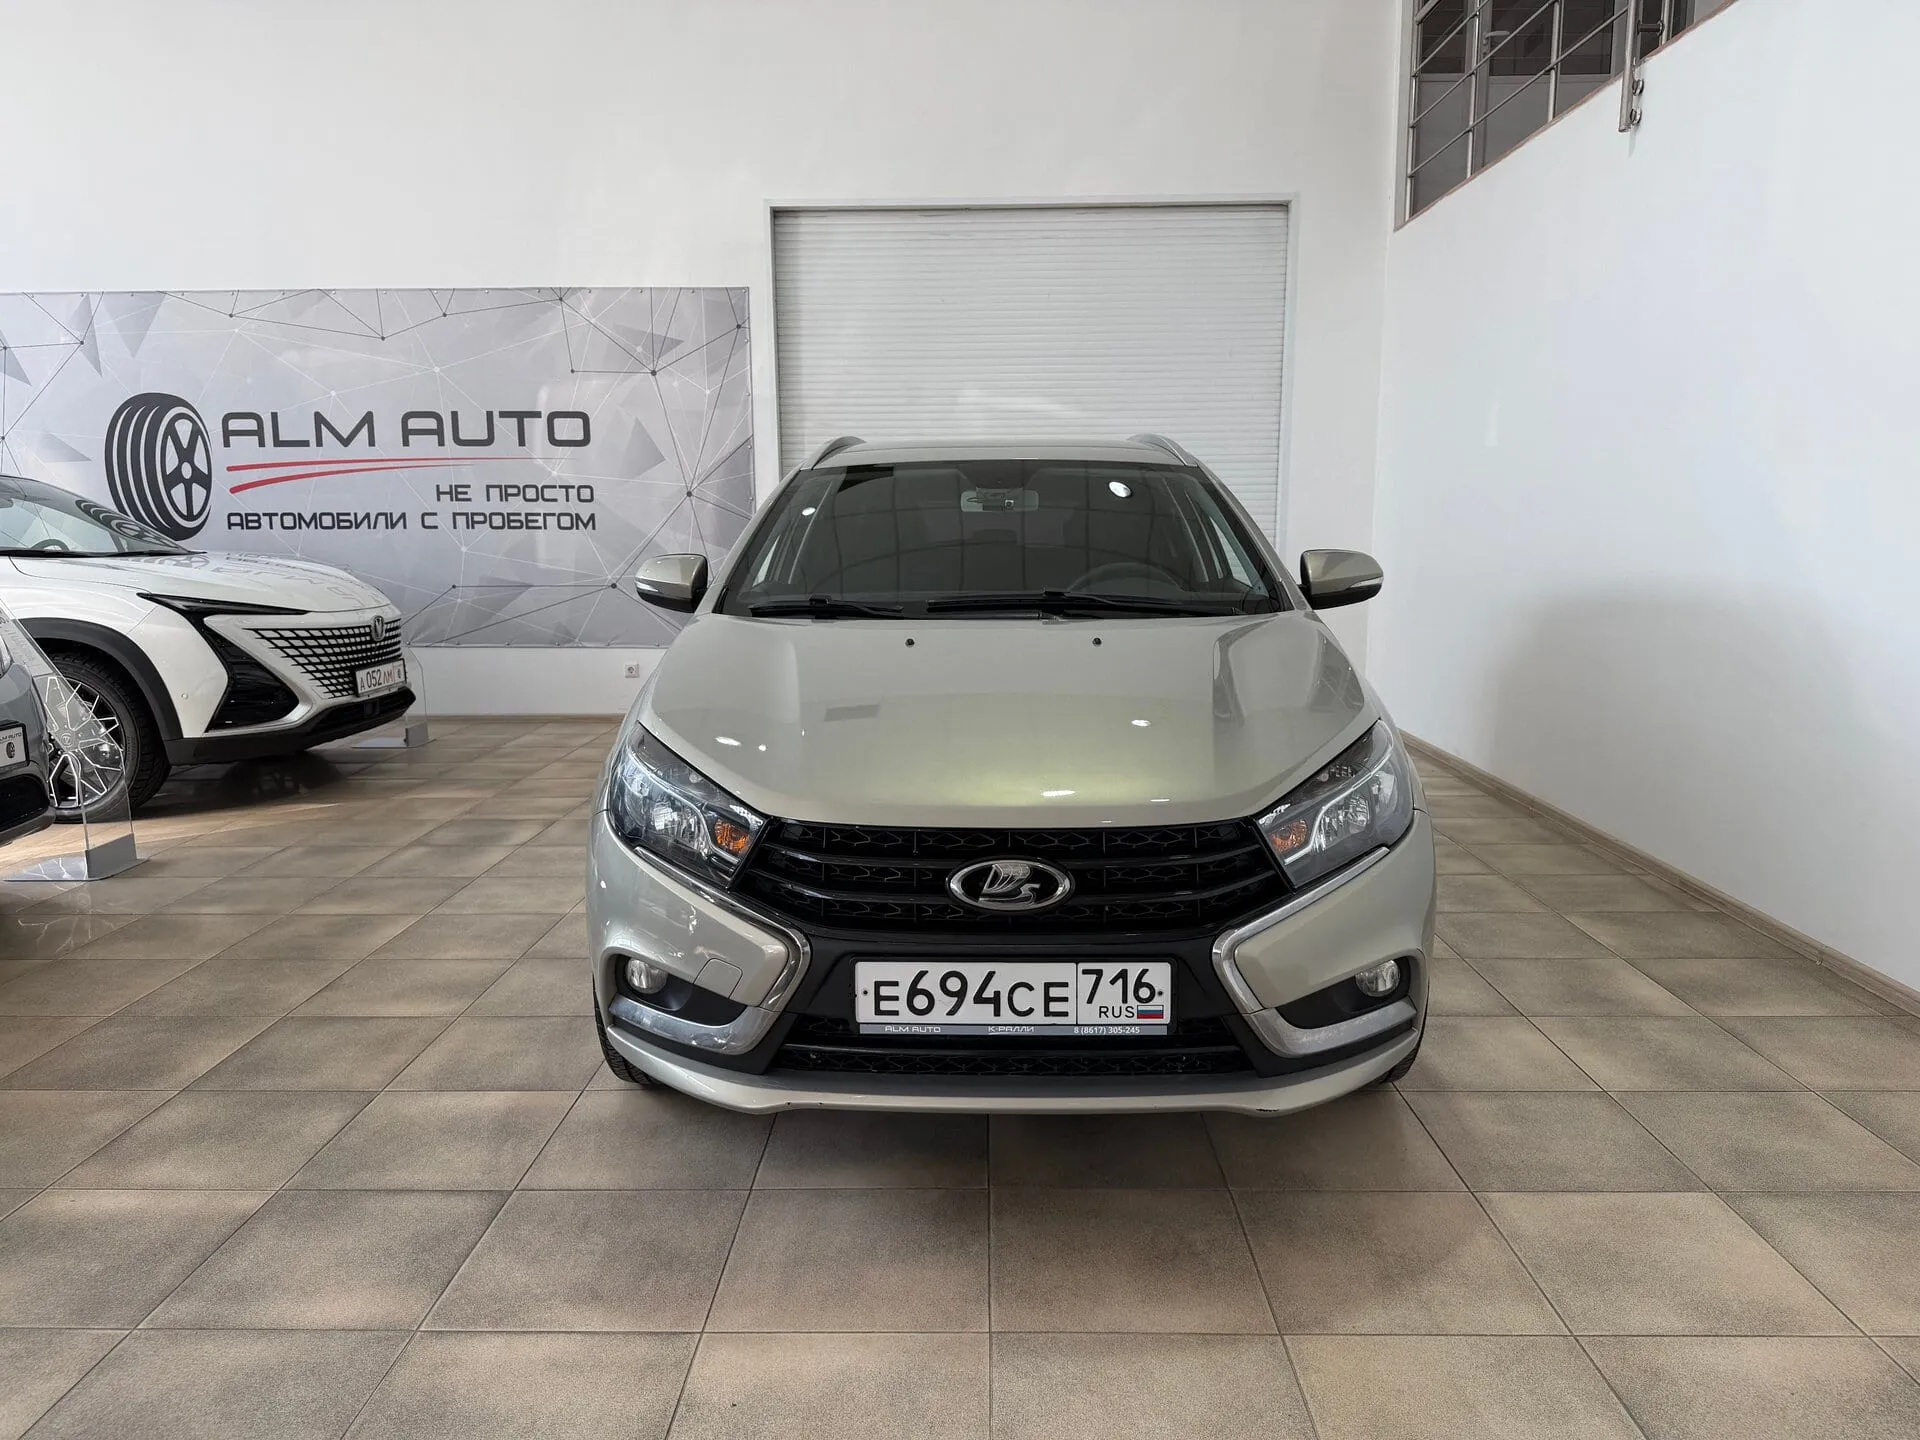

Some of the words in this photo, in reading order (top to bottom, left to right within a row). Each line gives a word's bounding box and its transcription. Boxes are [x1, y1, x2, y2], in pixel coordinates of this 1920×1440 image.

[221, 410, 376, 448] ALM
[401, 410, 591, 447] AUTO
[435, 484, 472, 502] НЕ
[485, 484, 595, 503] ПРОСТО
[226, 511, 407, 531] АВТОМОБИЛИ
[420, 511, 439, 530] С
[452, 511, 596, 531] ПРОБЕГОМ
[1081, 968, 1156, 1005] 716
[1098, 1005, 1135, 1019] RUS
[884, 1025, 909, 1033] ALM
[911, 1025, 941, 1033] AUTO
[1073, 1026, 1079, 1034] 8
[1108, 1026, 1140, 1034] 305-245
